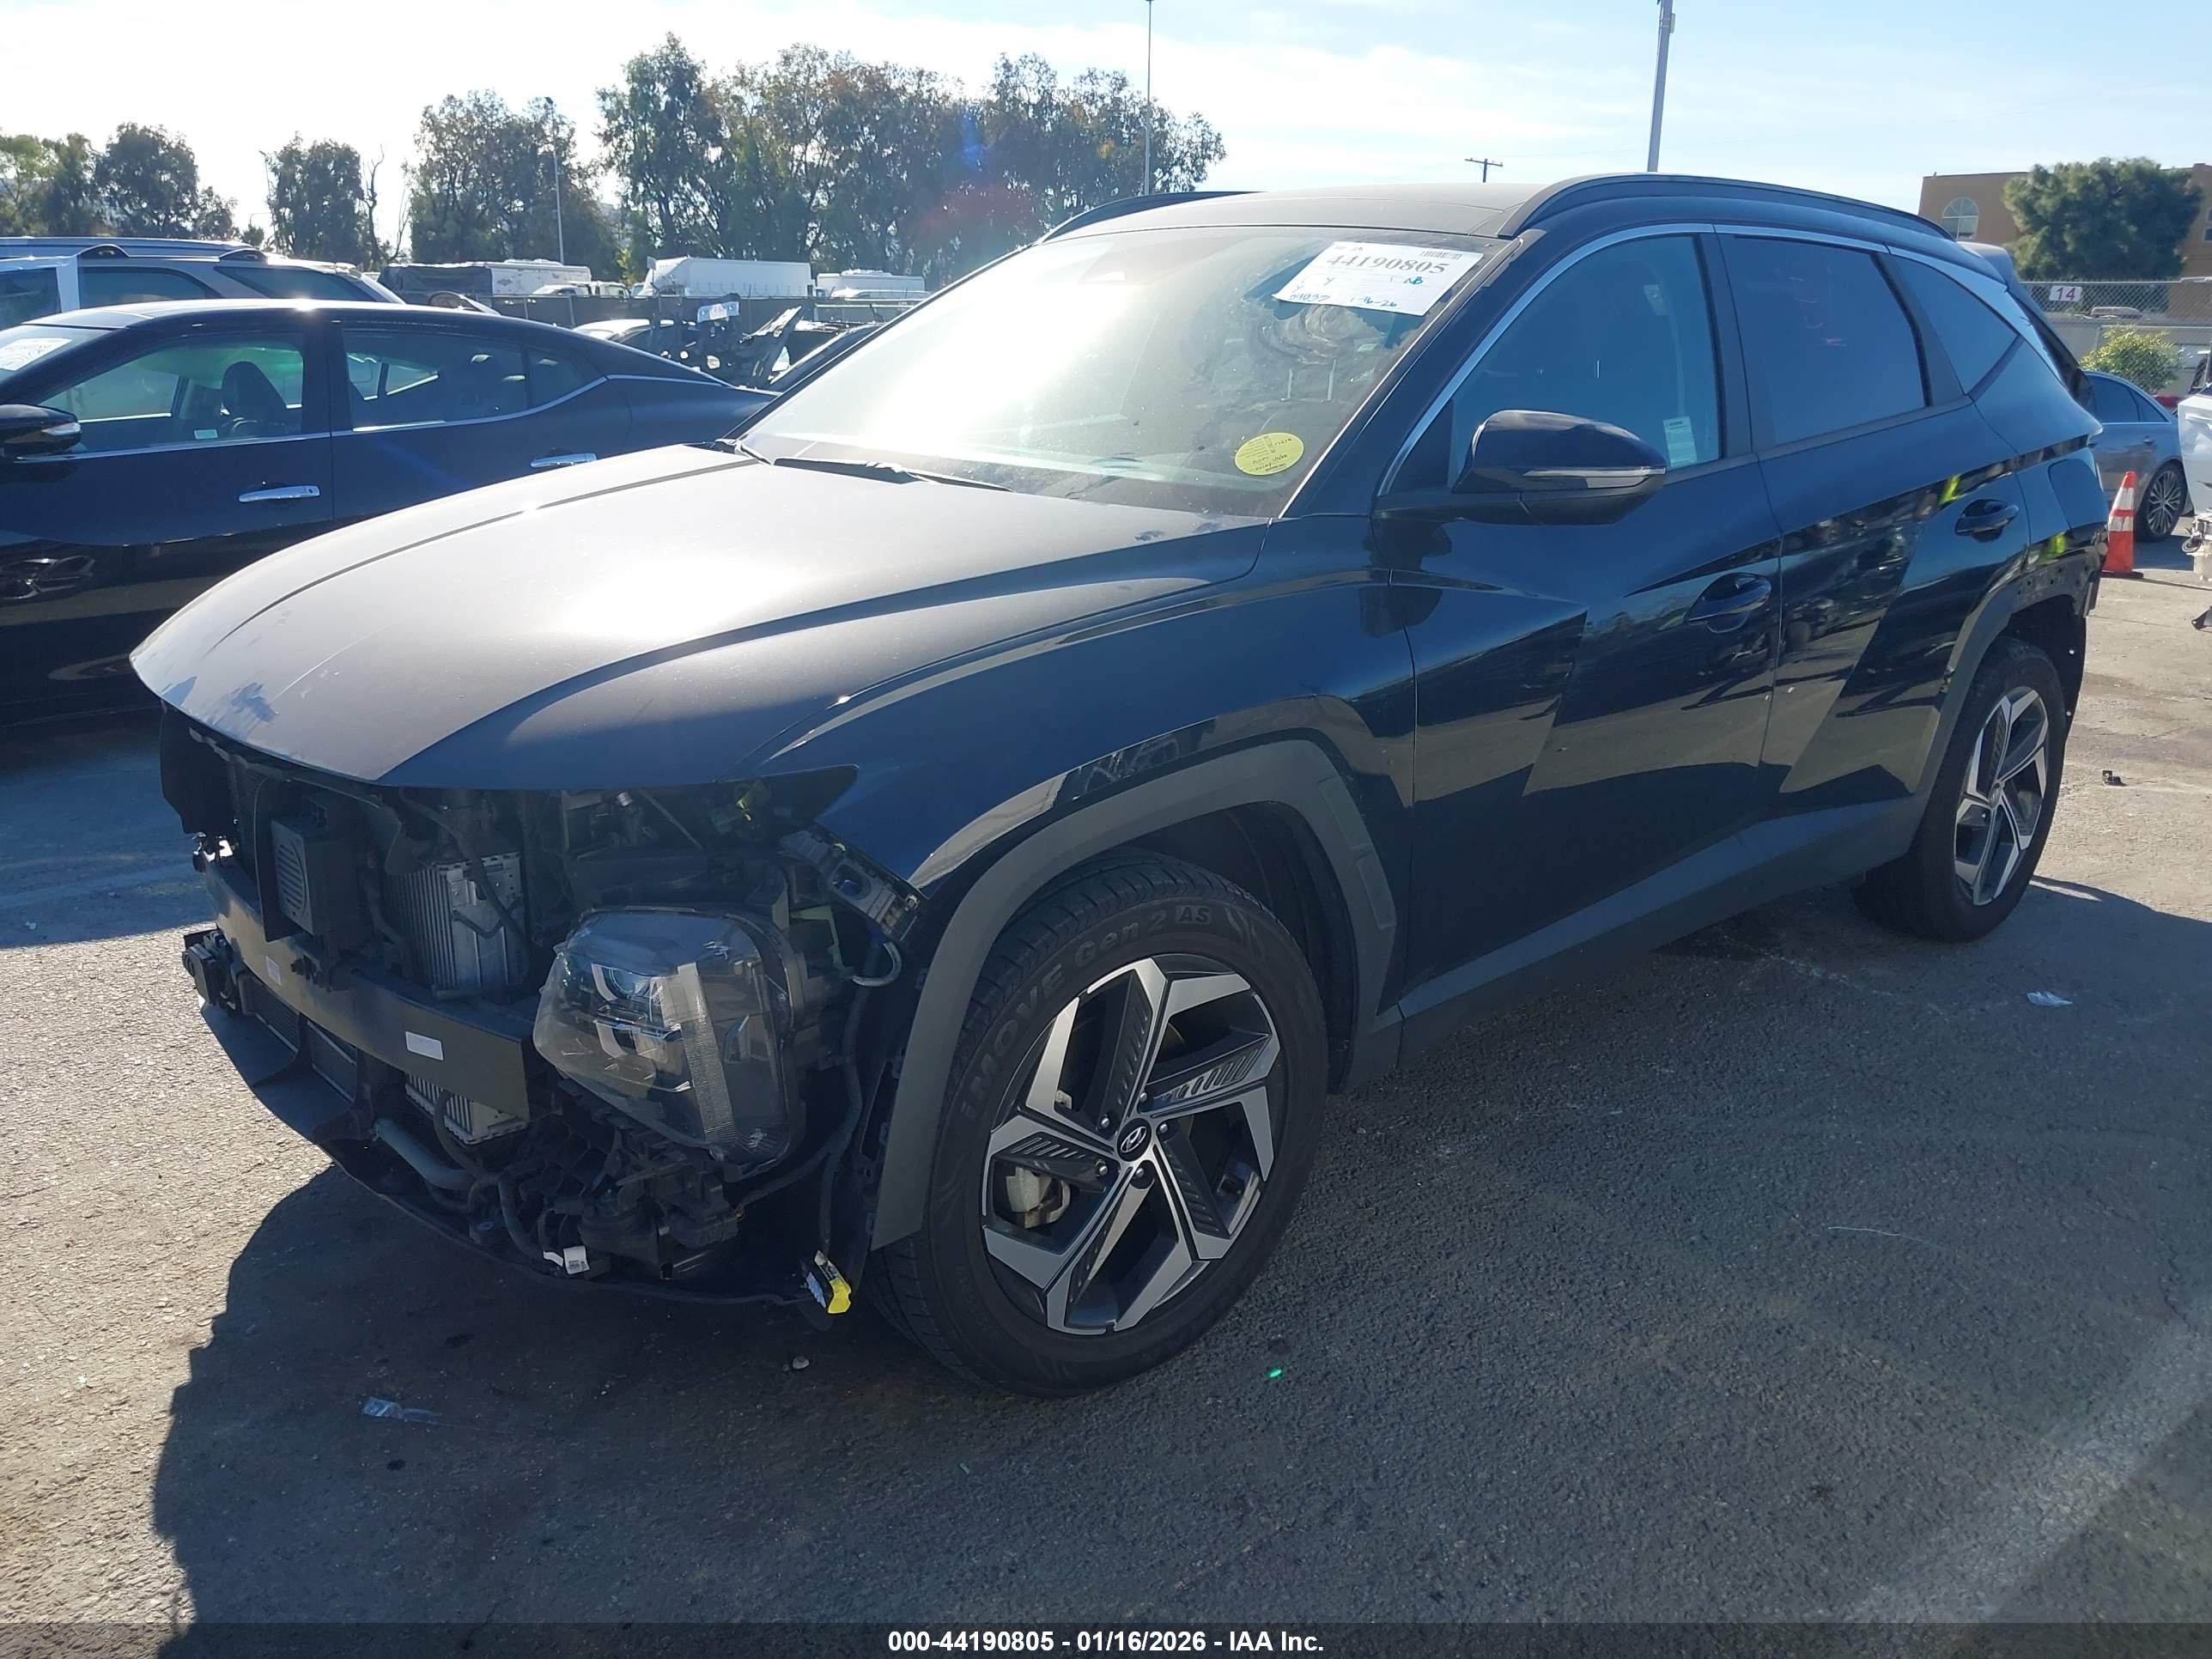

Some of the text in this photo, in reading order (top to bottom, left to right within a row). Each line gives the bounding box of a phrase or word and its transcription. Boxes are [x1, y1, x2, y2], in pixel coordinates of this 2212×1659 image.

[1327, 255, 1449, 273] 44190805
[2057, 288, 2075, 300] 14
[1179, 906, 1211, 924] AS
